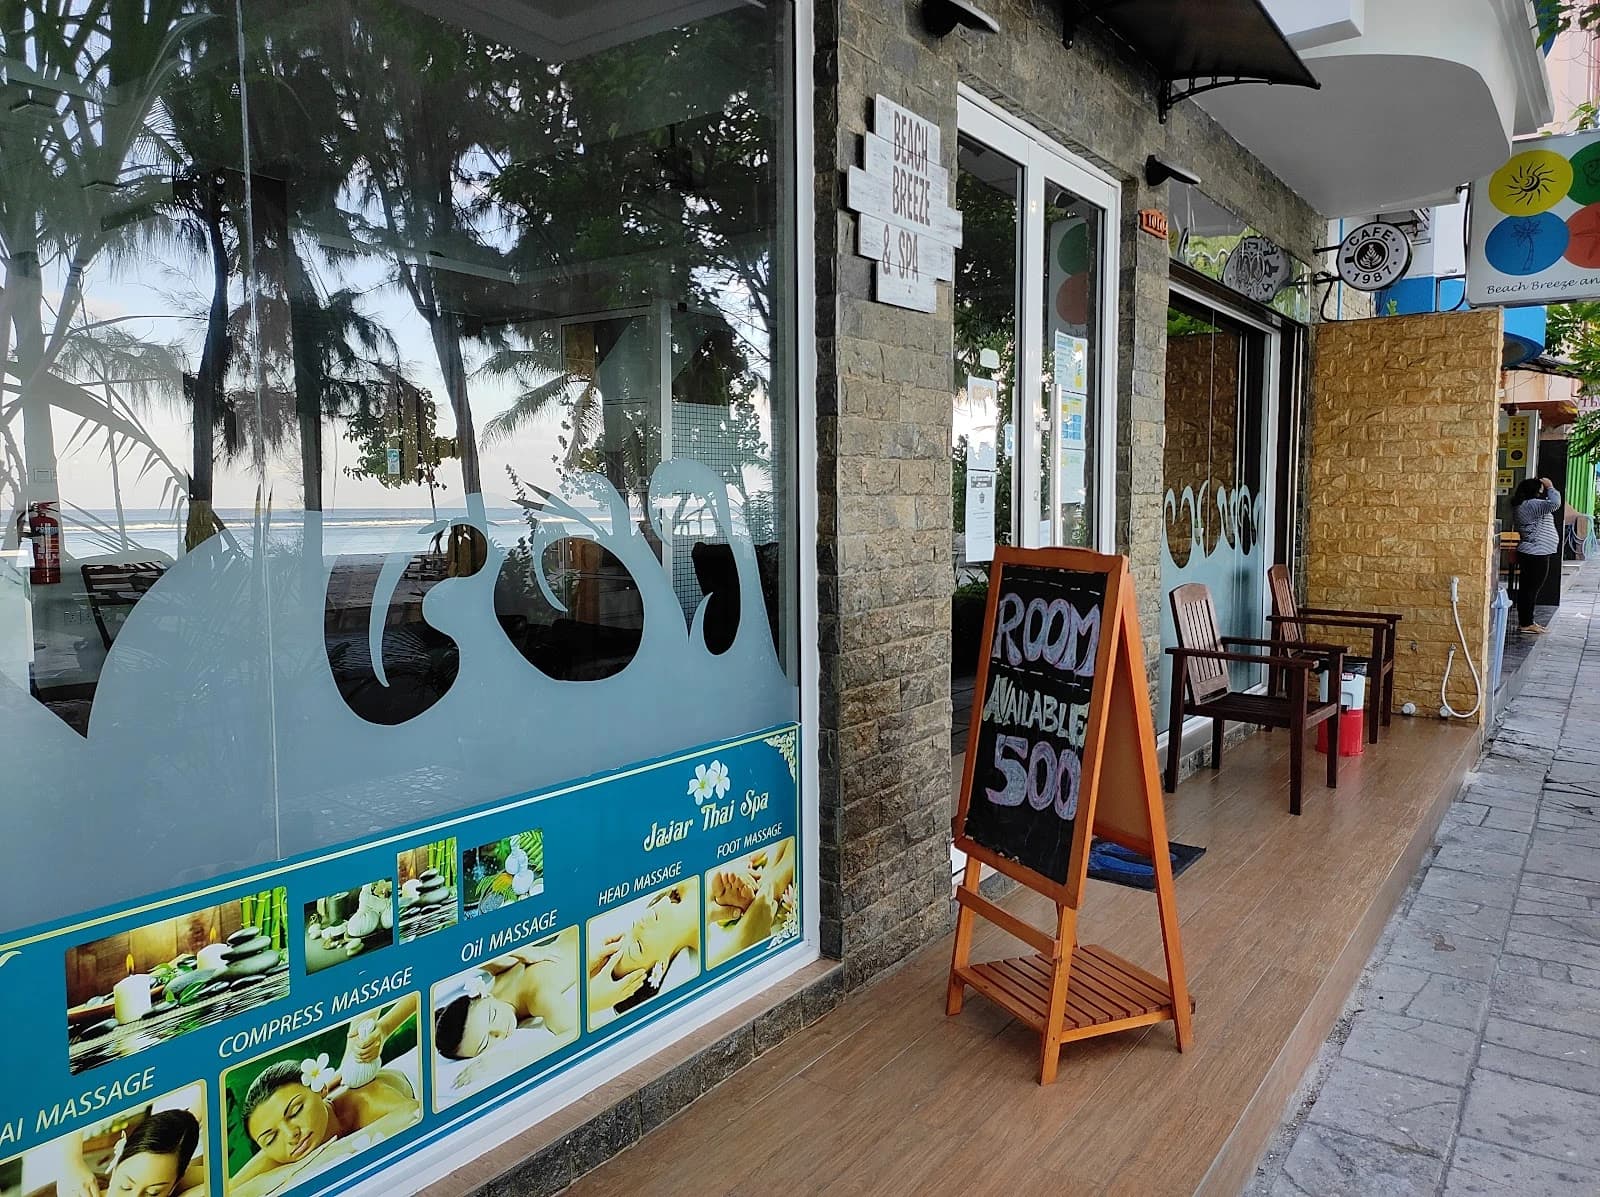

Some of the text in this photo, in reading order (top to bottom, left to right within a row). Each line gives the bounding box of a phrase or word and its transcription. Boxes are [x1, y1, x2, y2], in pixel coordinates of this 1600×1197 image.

[893, 111, 928, 176] BEACH
[892, 165, 931, 227] BREEZE
[882, 224, 919, 283] & SPA
[1349, 227, 1393, 246] CAFE
[1353, 265, 1392, 284] 1987
[1487, 282, 1529, 294] Beach
[1531, 279, 1579, 291] Breeze
[992, 592, 1101, 677] ROOM
[982, 674, 1090, 749] AVAILABLE
[985, 733, 1082, 821] 500
[700, 799, 735, 832] Thai
[740, 789, 769, 821] Spa
[716, 822, 783, 859] FOOT MASSAGE
[598, 861, 682, 907] HEAD MASSAGE
[461, 909, 558, 962] Oil MASSAGE
[218, 967, 413, 1059] COMPRESS MASSAGE
[35, 1066, 156, 1133] MASSAGE
